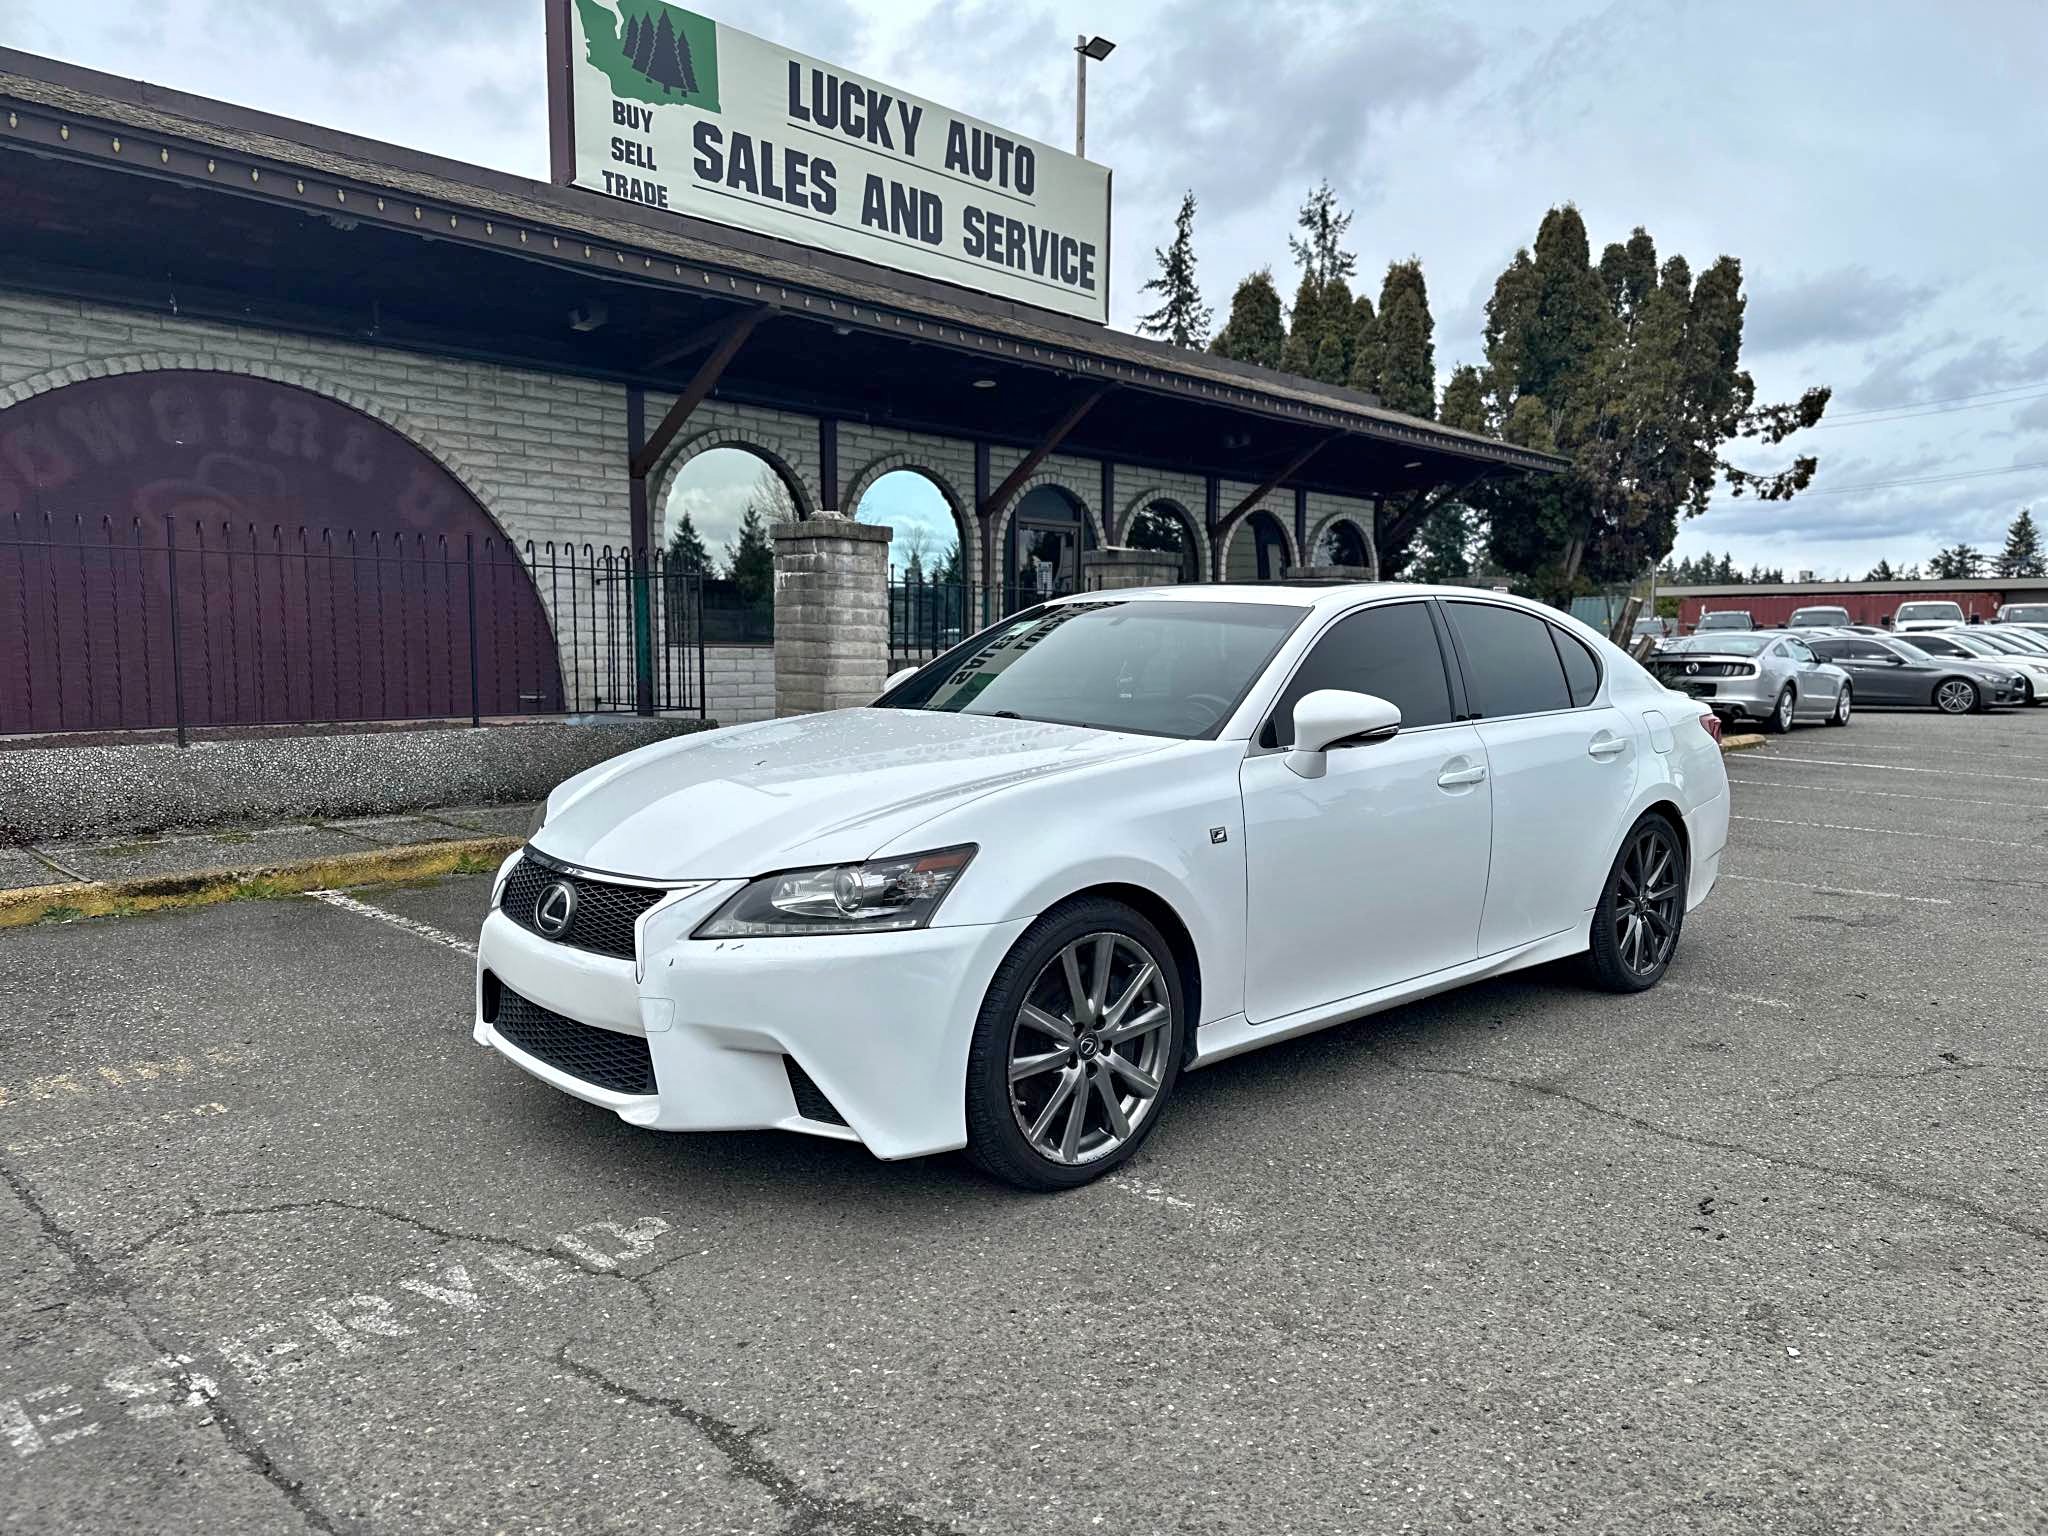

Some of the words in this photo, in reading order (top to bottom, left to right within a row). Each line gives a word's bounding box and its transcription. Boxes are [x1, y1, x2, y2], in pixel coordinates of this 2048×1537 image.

[611, 136, 657, 172] SELL
[612, 99, 654, 134] BUY
[788, 60, 922, 156] LUCKY
[945, 119, 1036, 197] AUTO
[601, 170, 669, 208] TRADE
[693, 121, 838, 216] SALES
[861, 173, 943, 246] AND
[963, 206, 1097, 291] SERVICE
[0, 383, 379, 512] OWGIRL
